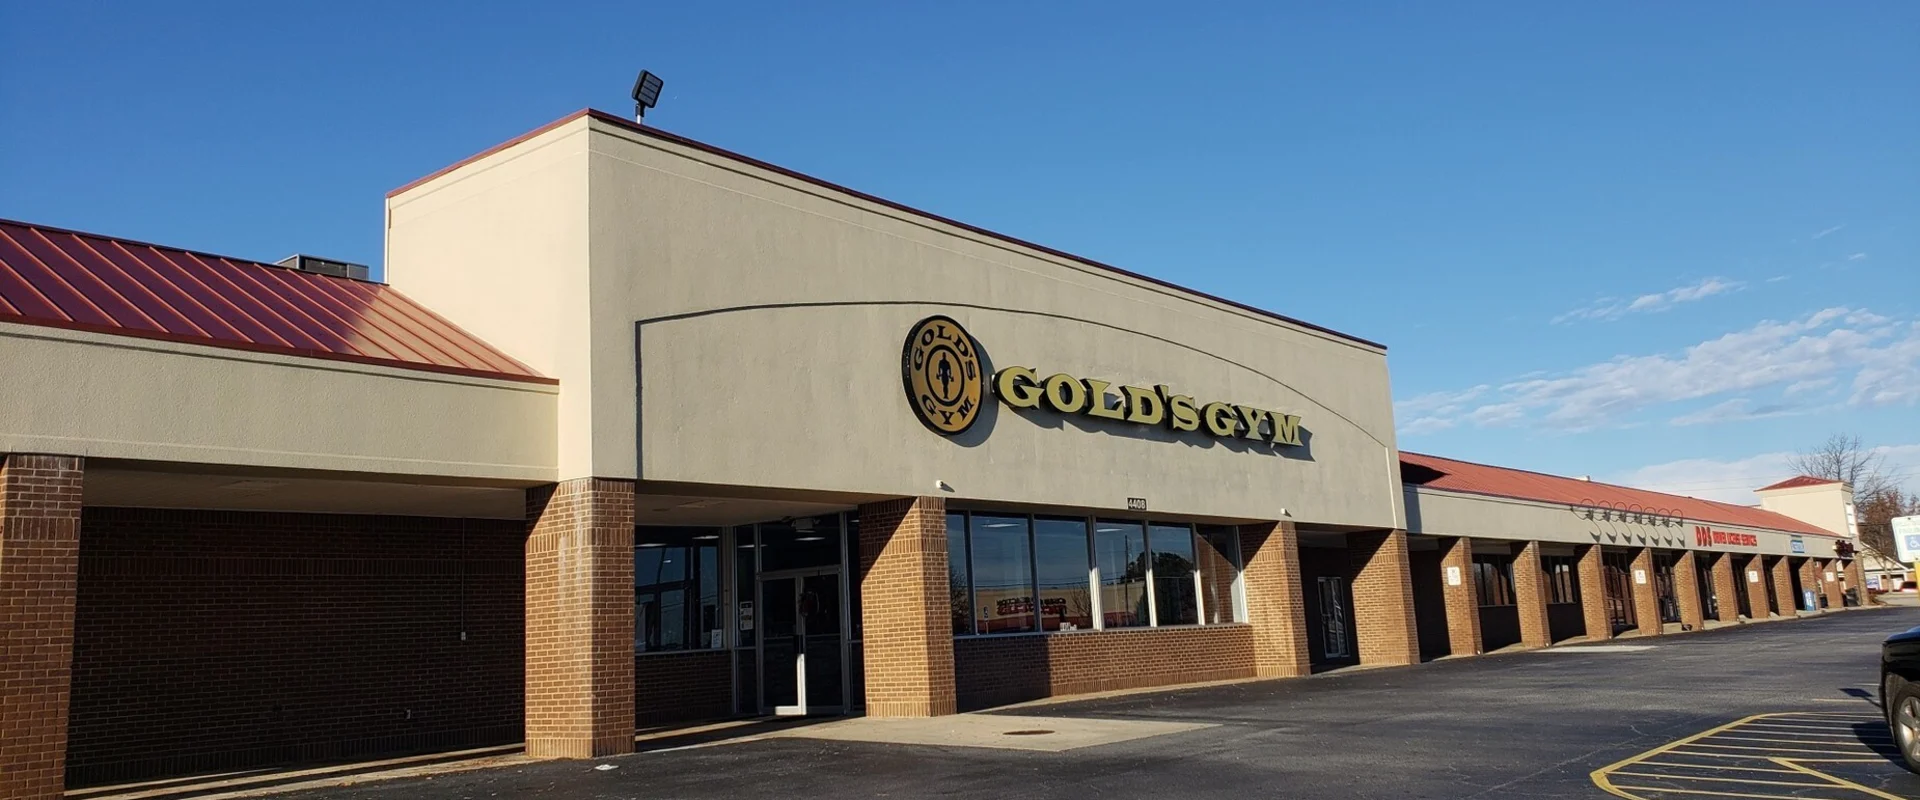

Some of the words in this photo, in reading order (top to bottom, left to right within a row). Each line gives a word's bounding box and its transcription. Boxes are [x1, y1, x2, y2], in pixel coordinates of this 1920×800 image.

[913, 324, 977, 381] GOLD'S
[920, 394, 975, 426] GYM
[995, 366, 1200, 432] GOLD'S
[1201, 401, 1305, 447] GYM
[1128, 498, 1146, 510] 4408
